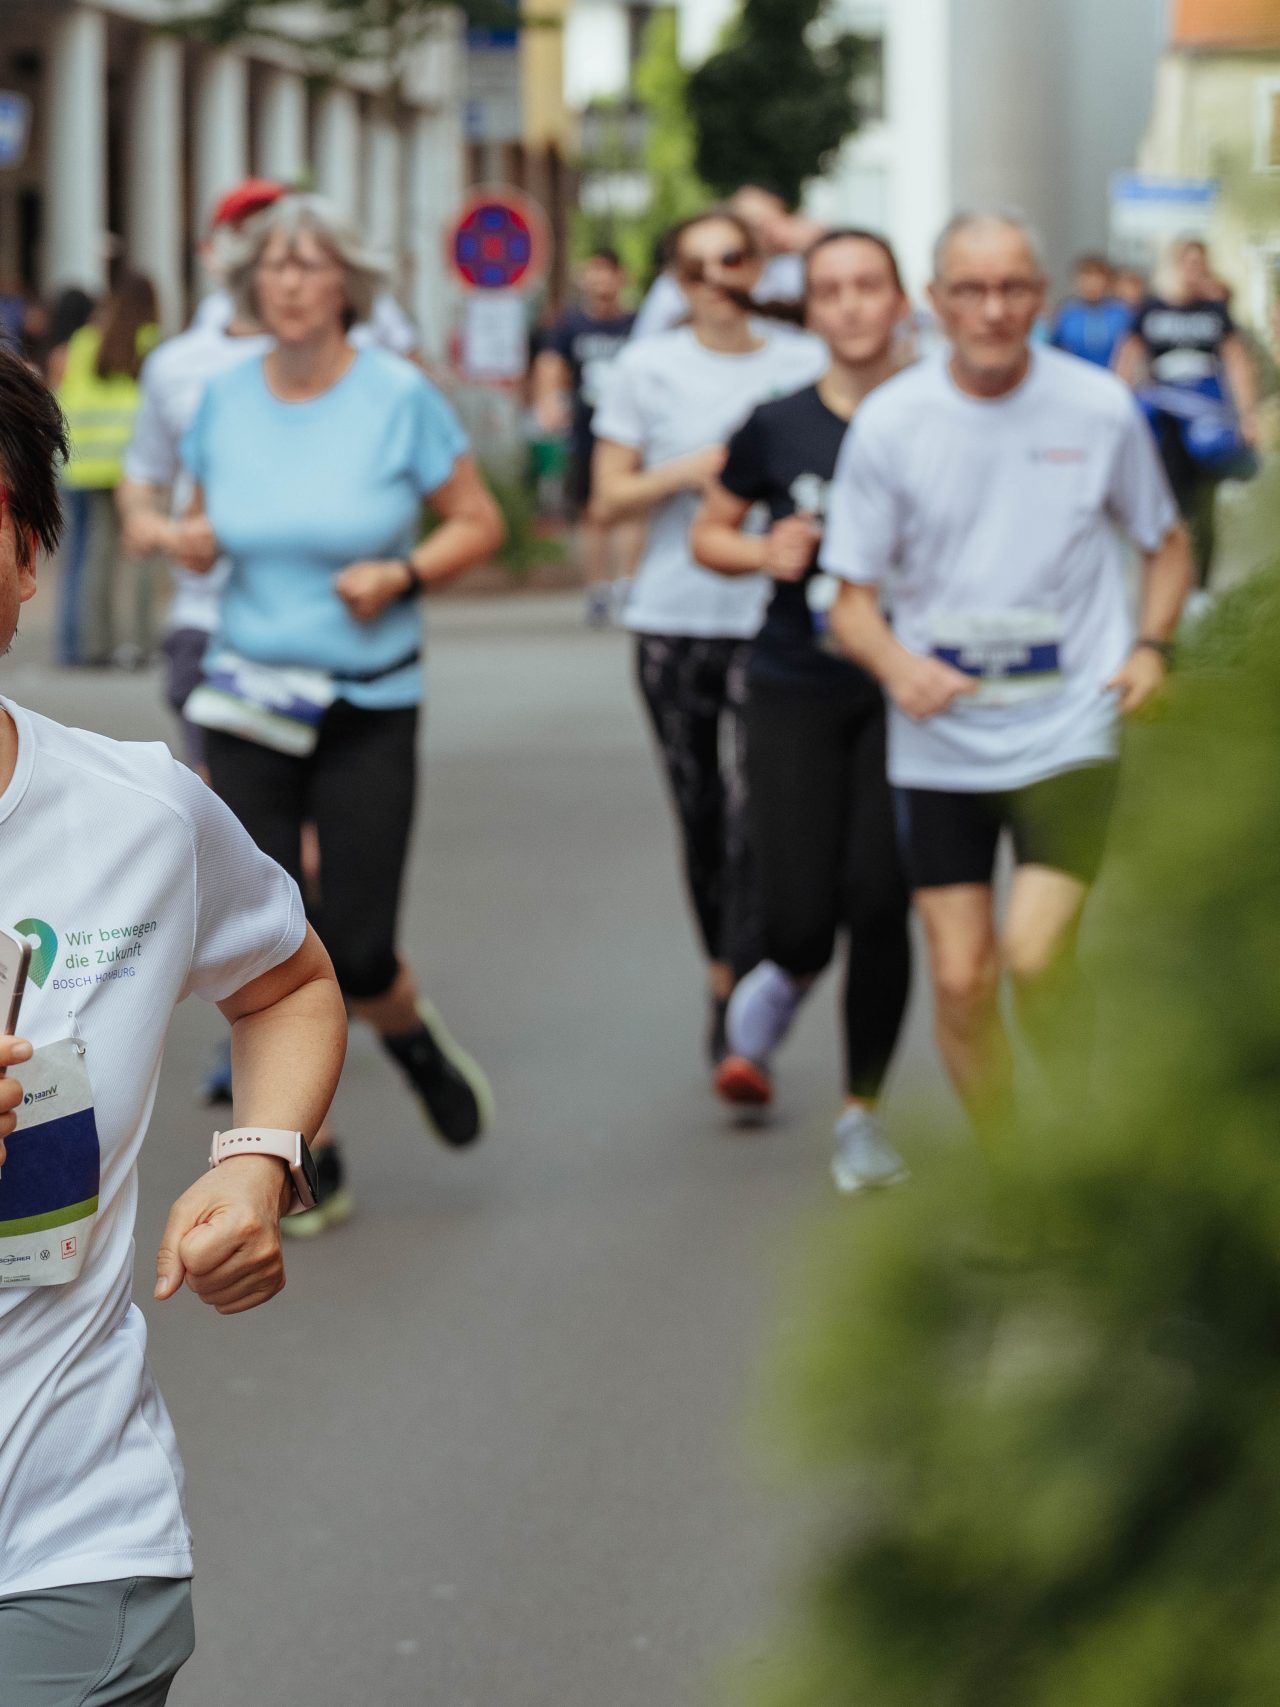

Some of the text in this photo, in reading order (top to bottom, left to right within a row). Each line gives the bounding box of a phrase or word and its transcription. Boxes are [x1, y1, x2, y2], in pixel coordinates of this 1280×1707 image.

[65, 920, 157, 946] Wir bewegen
[65, 942, 142, 969] die Zukunft
[53, 967, 136, 990] BOSCH HOMBURG
